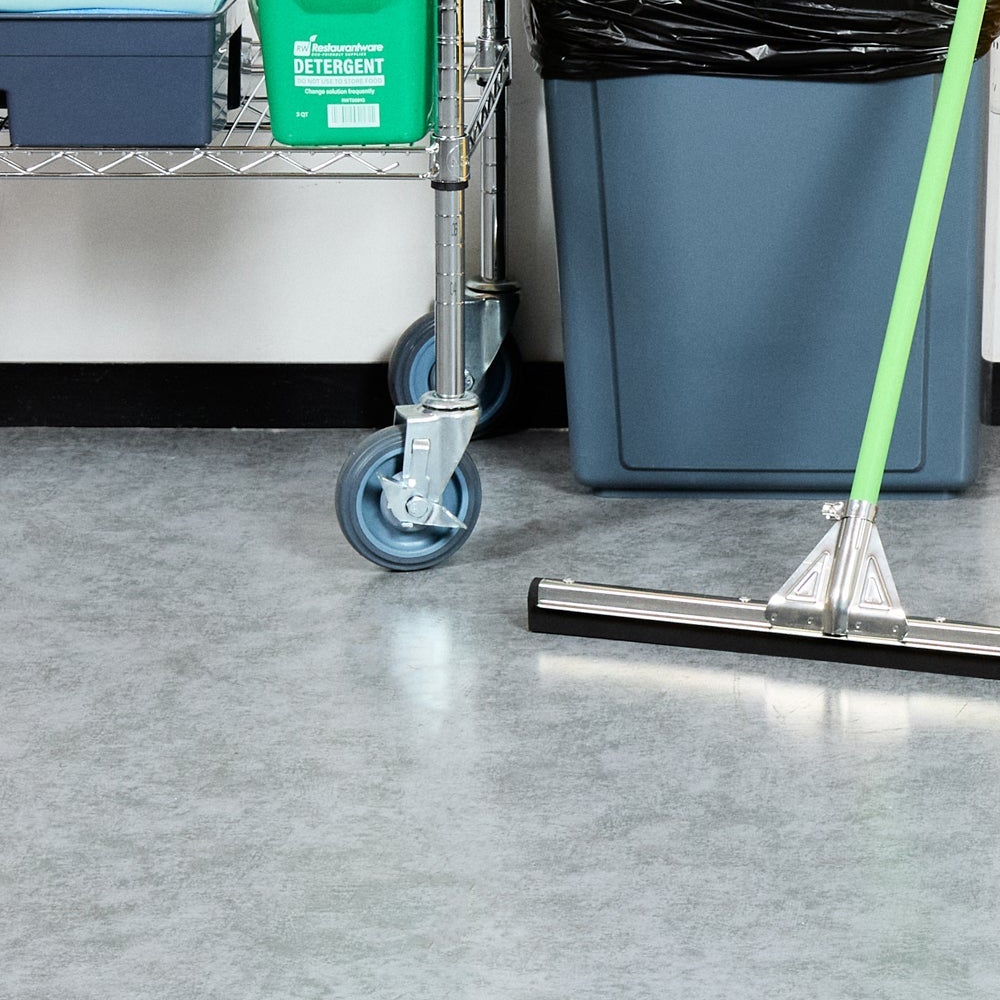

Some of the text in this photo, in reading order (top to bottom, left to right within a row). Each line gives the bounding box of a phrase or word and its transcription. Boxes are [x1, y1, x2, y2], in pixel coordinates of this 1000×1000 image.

[312, 43, 384, 52] Restaurantware
[294, 58, 384, 74] DETERGENT
[321, 77, 333, 85] USE
[335, 77, 343, 85] TO
[344, 77, 363, 85] STORE
